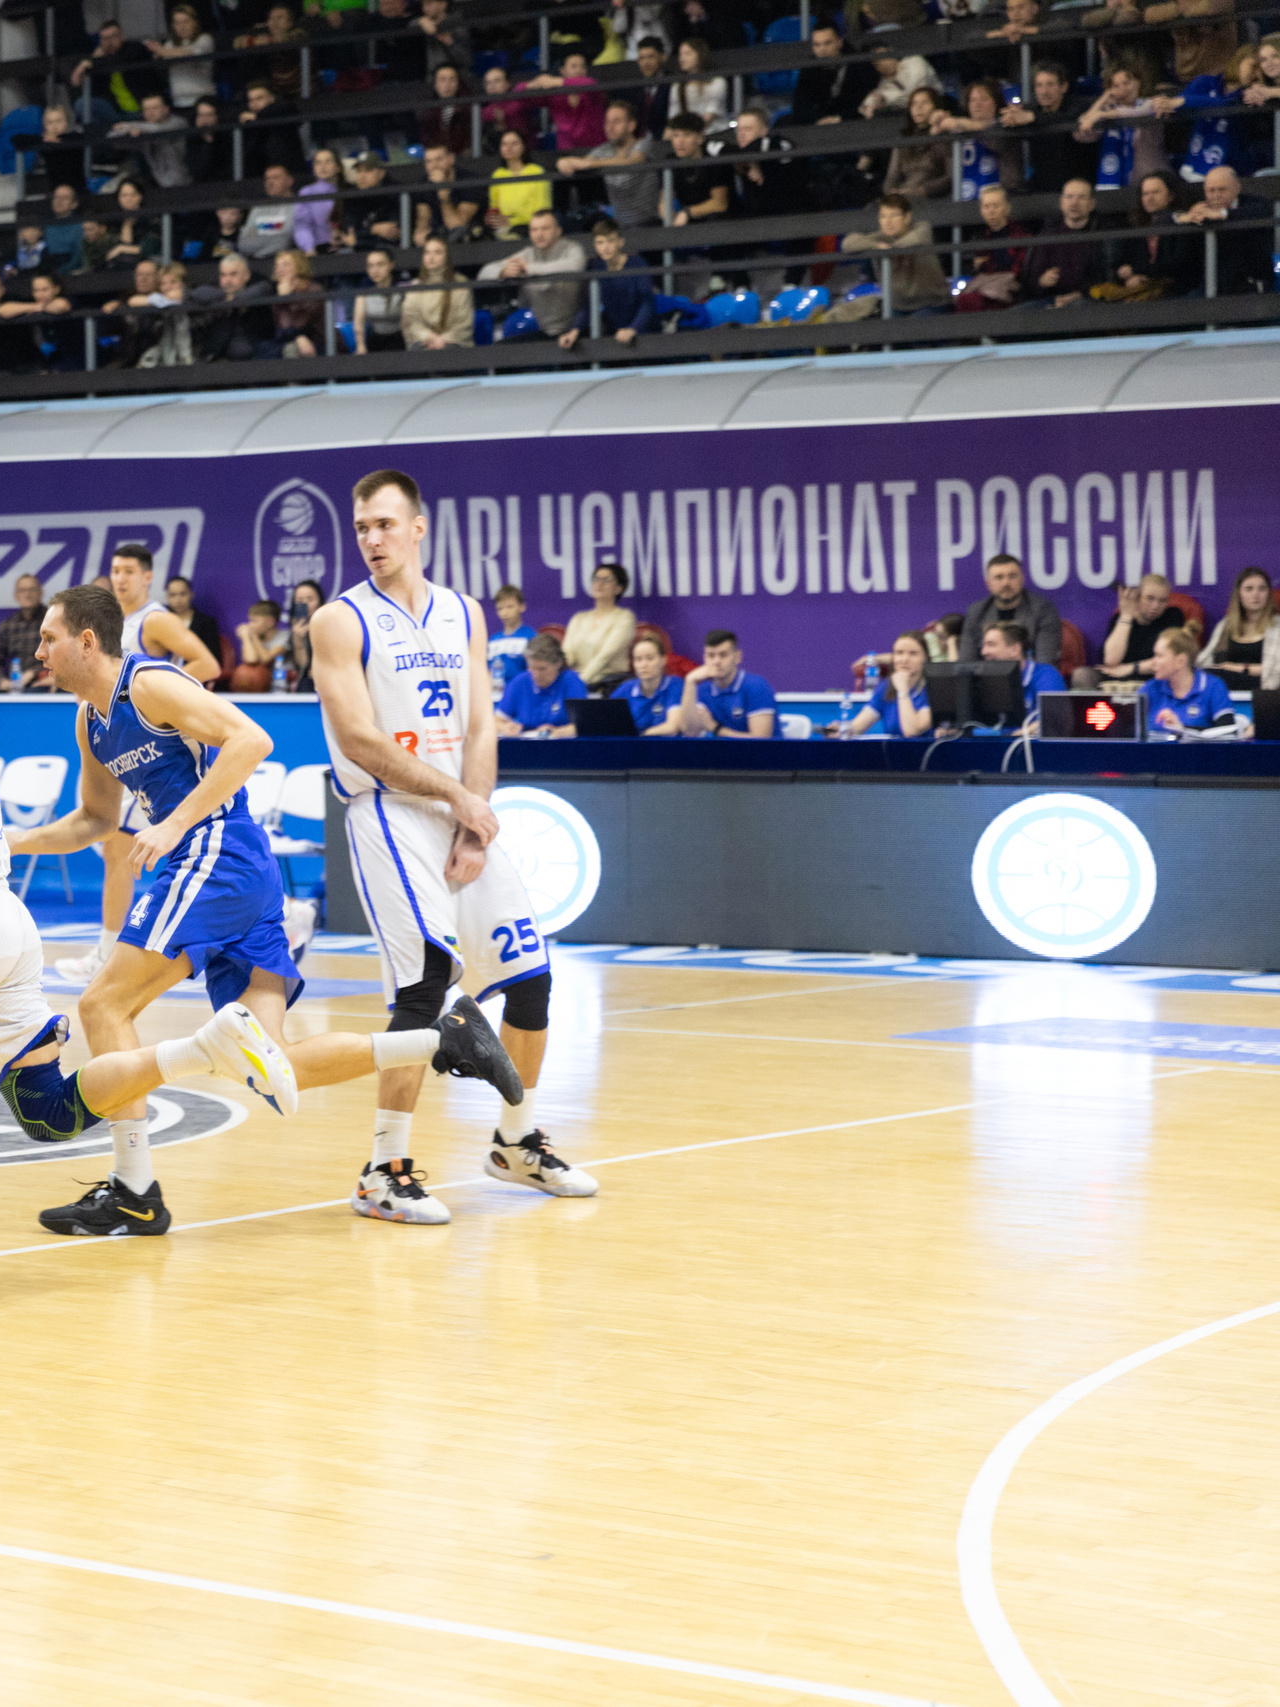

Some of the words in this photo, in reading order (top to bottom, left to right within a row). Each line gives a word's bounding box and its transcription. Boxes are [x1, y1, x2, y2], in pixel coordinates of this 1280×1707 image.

[935, 468, 1218, 592] РОССИИ
[417, 680, 454, 718] 25
[128, 892, 154, 930] 4
[491, 917, 540, 964] 25
